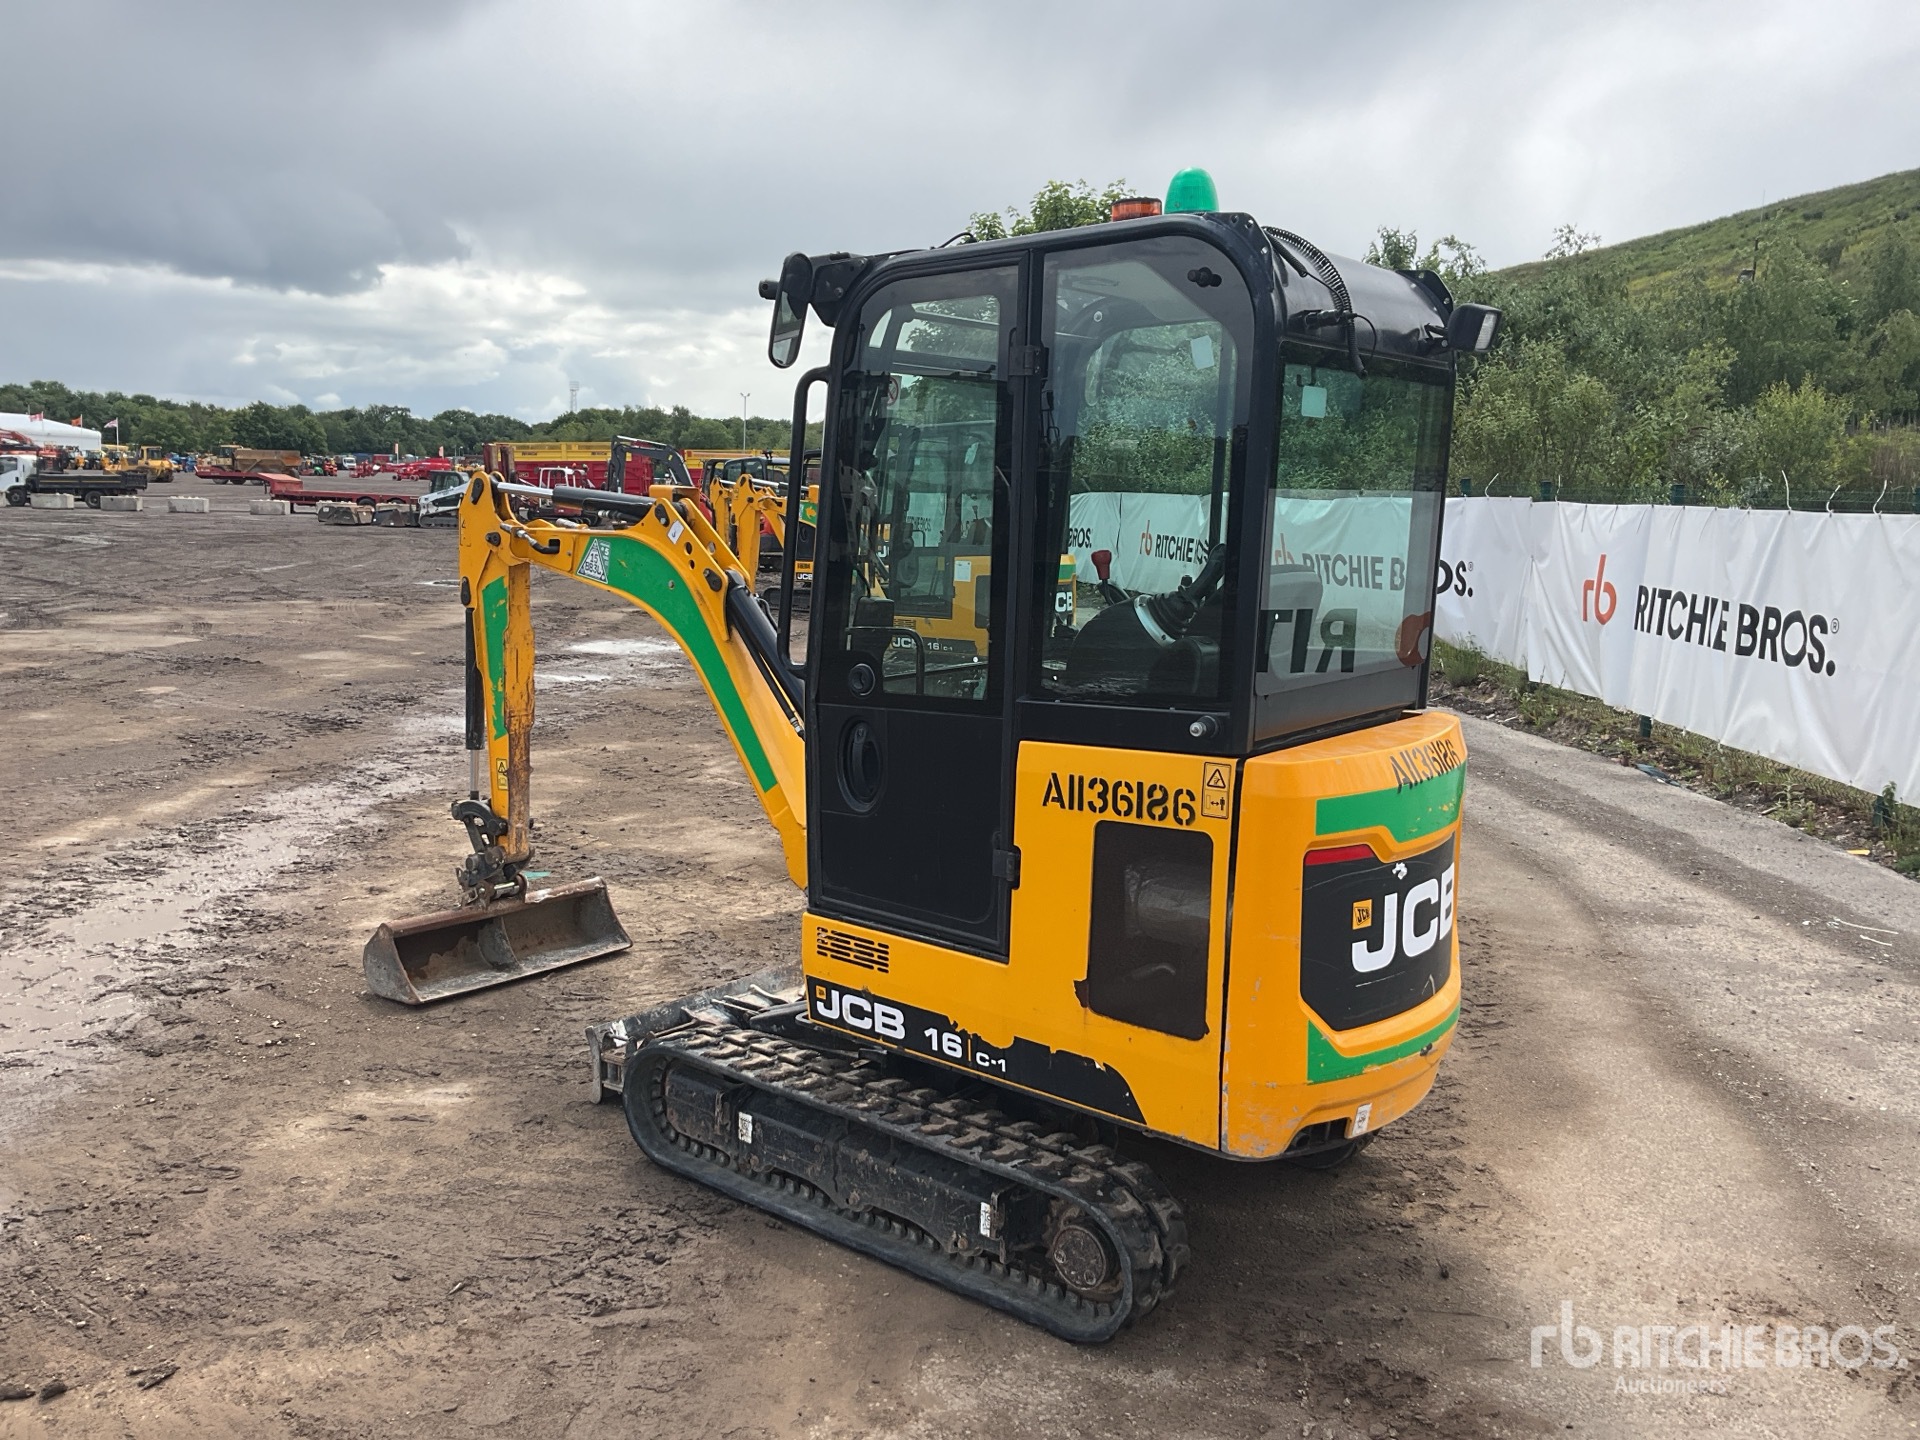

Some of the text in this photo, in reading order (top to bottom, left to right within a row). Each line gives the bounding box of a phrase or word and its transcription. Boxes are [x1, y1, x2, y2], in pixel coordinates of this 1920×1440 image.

[1155, 534, 1195, 563] RITCHIE
[1302, 553, 1384, 590] RITCHIE
[1055, 591, 1073, 613] CB
[1633, 585, 1730, 652] RITCHIE
[927, 642, 940, 651] 16
[1042, 772, 1196, 826] A1136186
[1351, 861, 1455, 973] JCB
[1356, 906, 1371, 923] JCB
[816, 989, 906, 1040] JCB
[923, 1027, 963, 1059] 16
[975, 1052, 1006, 1073] C-1
